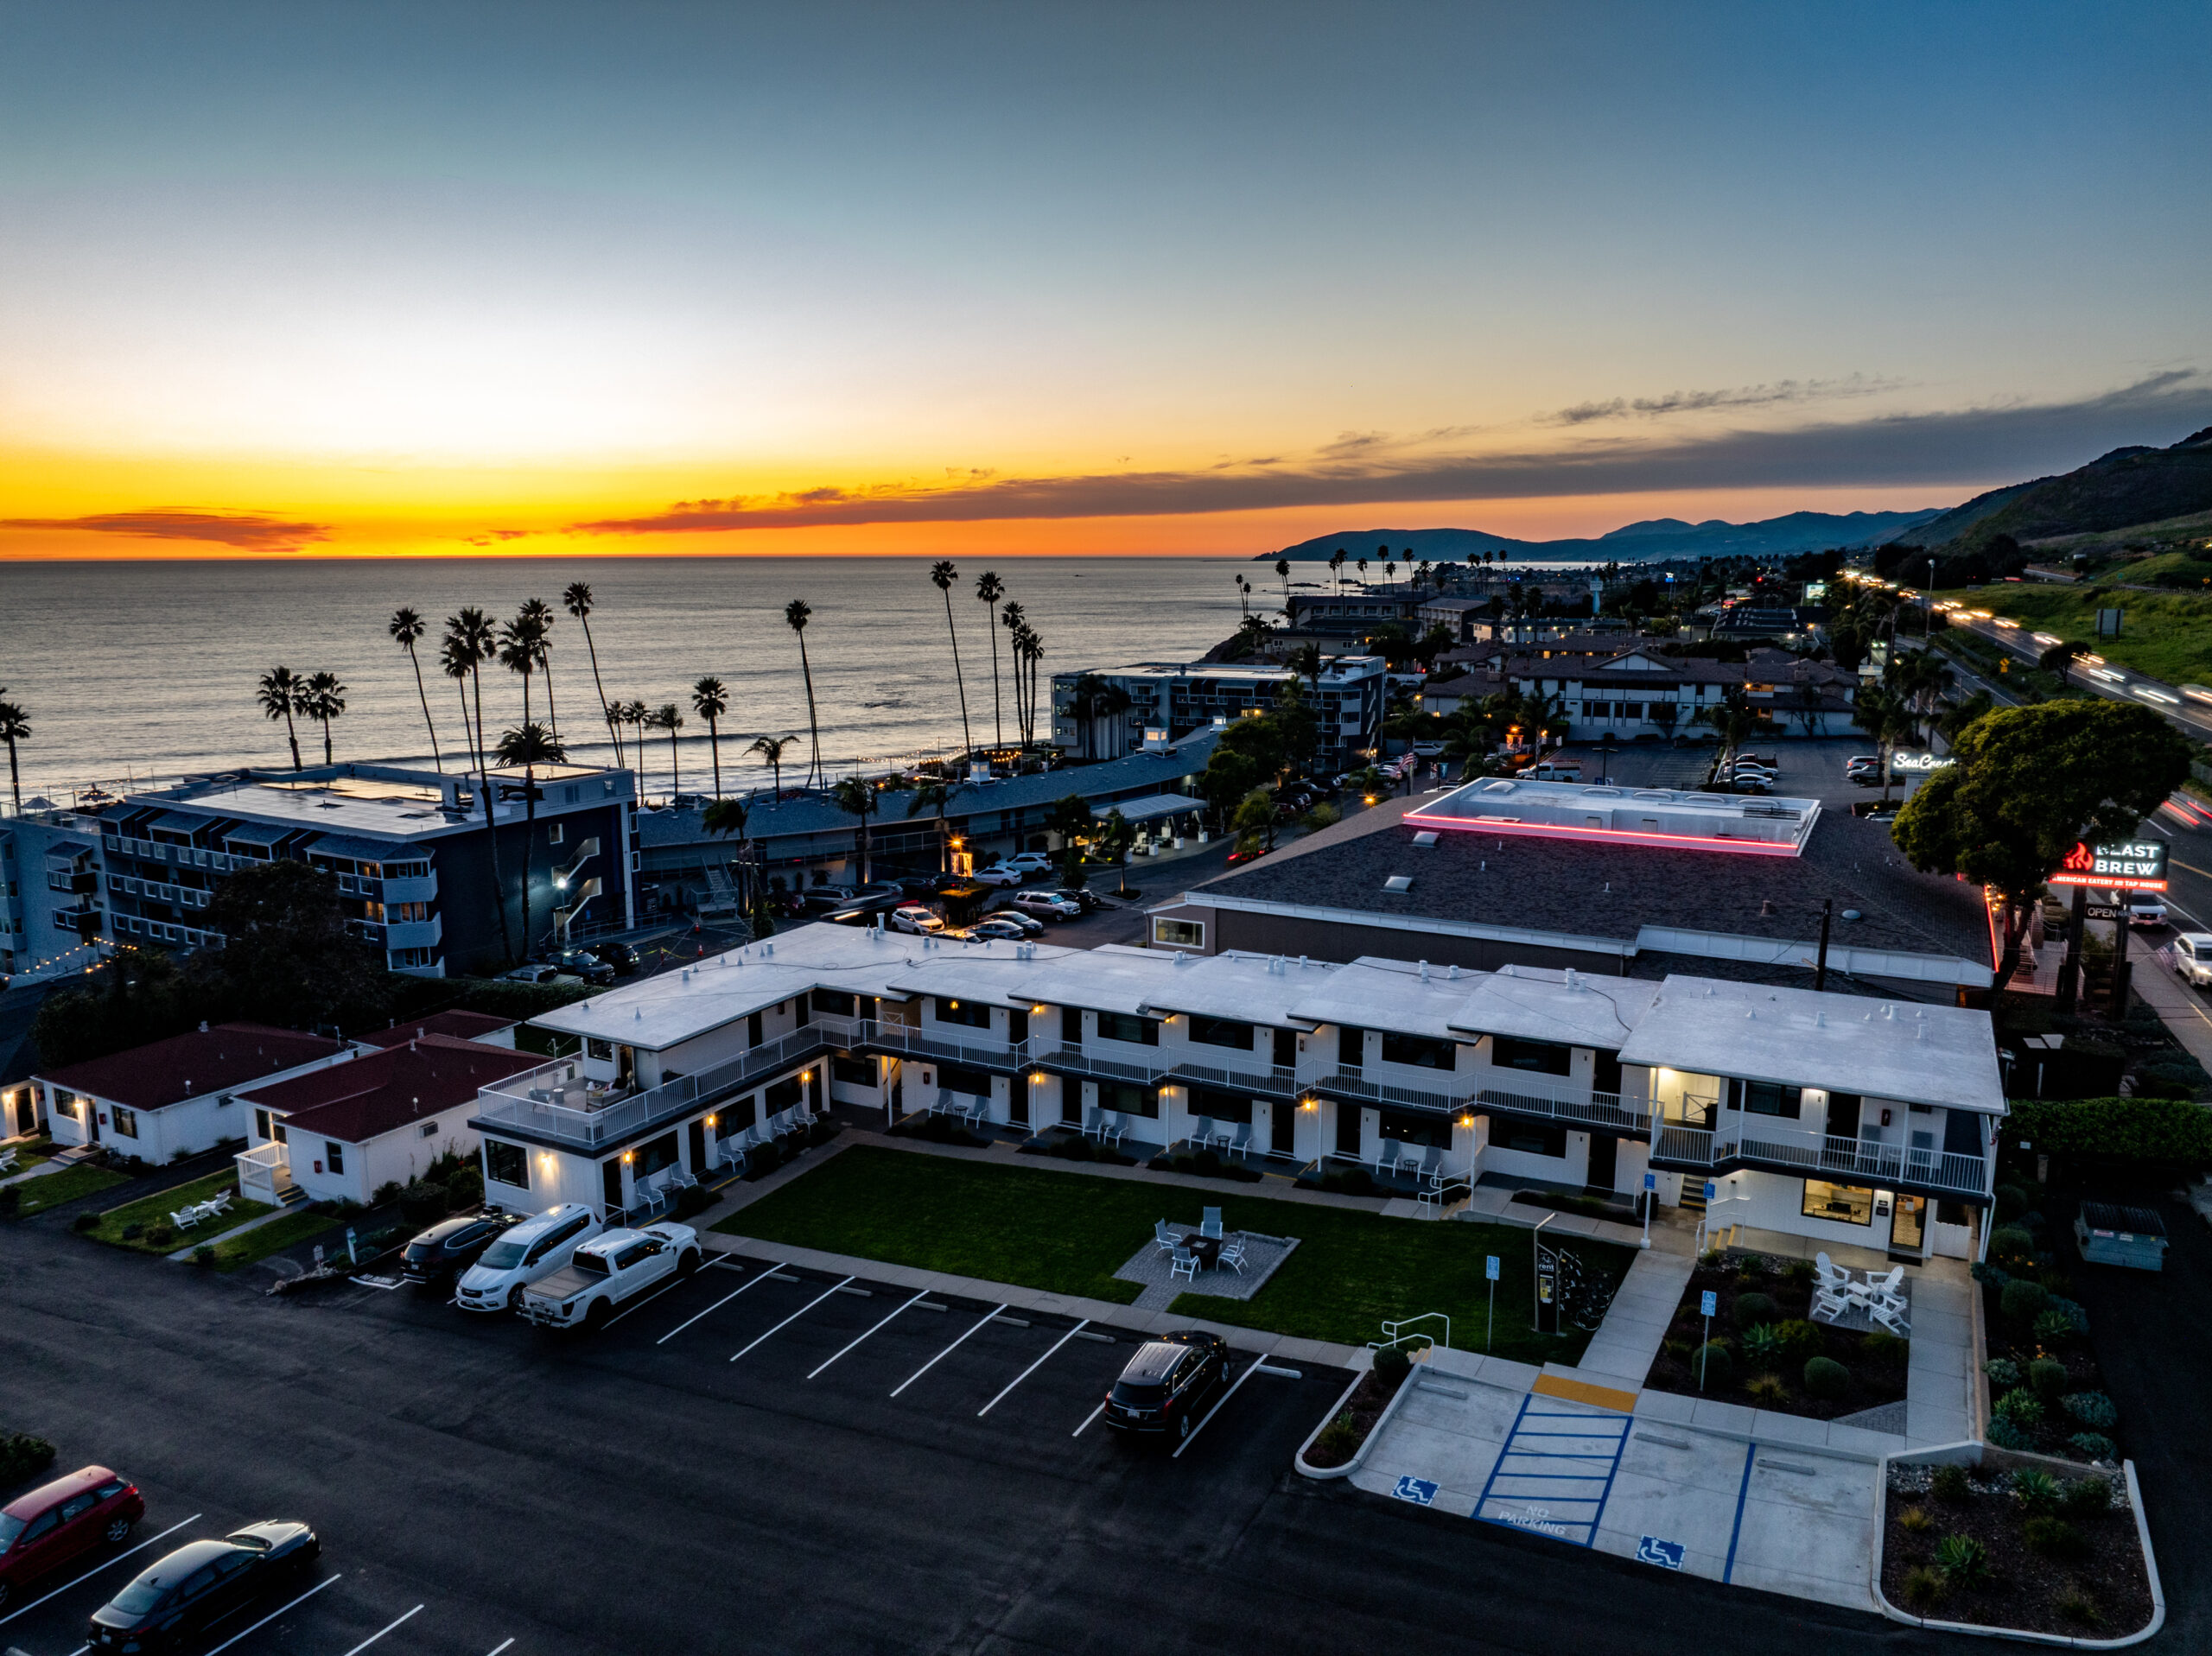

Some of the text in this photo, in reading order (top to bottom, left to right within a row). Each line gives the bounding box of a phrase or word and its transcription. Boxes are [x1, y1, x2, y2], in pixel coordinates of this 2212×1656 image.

[2095, 860, 2158, 875] BREW
[2088, 878, 2113, 886] EATERY
[2088, 907, 2117, 918] OPEN
[1526, 1505, 1549, 1518] NO
[1498, 1510, 1567, 1535] PARKING
